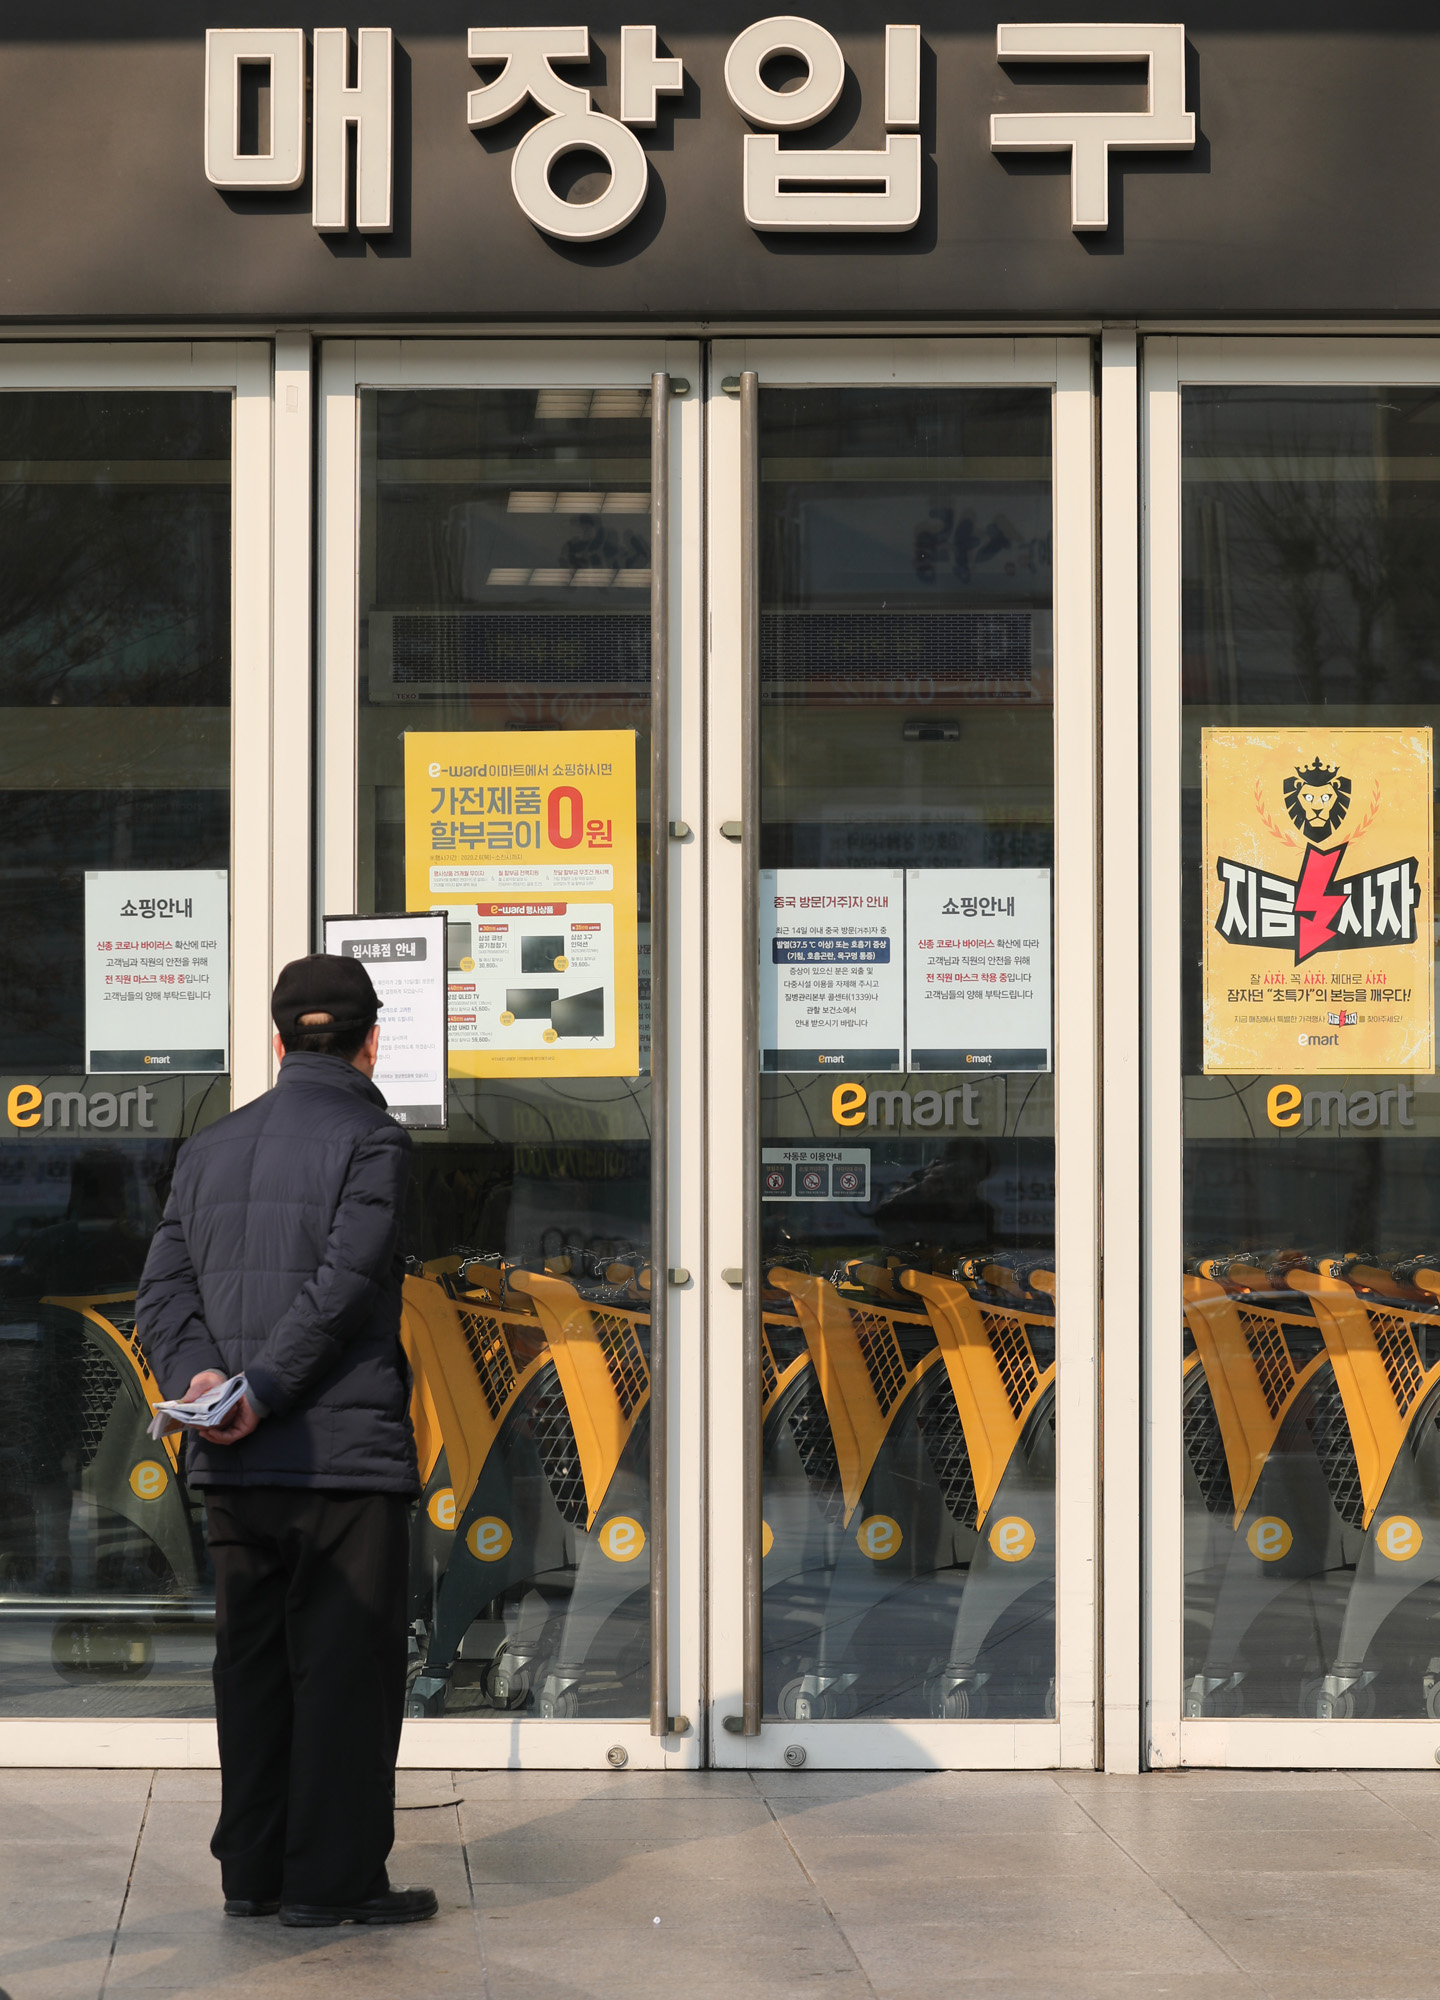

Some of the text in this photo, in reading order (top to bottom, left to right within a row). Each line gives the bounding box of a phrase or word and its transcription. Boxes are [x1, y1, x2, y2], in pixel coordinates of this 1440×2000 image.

[489, 764, 548, 776] 이마트에서
[553, 763, 612, 776] 쇼핑하시면
[431, 787, 541, 815] 가전제품
[430, 821, 540, 850] 할부금이
[773, 896, 888, 909] 중국 방문[거주]자 안내
[1222, 862, 1415, 938] 지금 사자
[120, 898, 192, 919] 쇼핑안내
[942, 897, 1014, 917] 쇼핑안내
[825, 927, 839, 935] 중국
[880, 926, 887, 934] 중
[97, 940, 217, 951] 신종 코로나 바이러스 확산에 따라
[818, 941, 834, 950] 이상)
[835, 941, 849, 950] 또는
[851, 941, 871, 950] 호흡기
[873, 941, 887, 950] 증상
[918, 939, 1039, 949] 신종 코로나 바이러스 확산에 따라
[352, 942, 416, 959] 임시휴점 안내
[787, 952, 875, 961] (기침, 호흡곤란, 목구멍 통증)
[927, 956, 1030, 966] 고객님과 직원의 안전을 위해
[106, 957, 208, 967] 고객님과 직원의 안전을 위해
[789, 967, 873, 975] 증상이 있으신 분은 외출 및
[105, 974, 209, 984] 전 직원 마스크 착용 중입니다
[926, 973, 1032, 983] 전 직원 마스크 착용 중입니다
[1250, 972, 1261, 986] 잘
[1290, 972, 1301, 986] 꼭
[1331, 972, 1362, 986] 제대로
[1365, 972, 1387, 986] 사자
[784, 980, 879, 988] 다중시설 이용을 자제해 주시고
[103, 991, 211, 1001] 고객님들의 양해 부탁드립니다
[925, 990, 1033, 1000] 고객님들의 양해 부탁드립니다
[1227, 988, 1264, 1003] 잠자던
[1330, 988, 1367, 1003] 본능을
[1370, 988, 1411, 1003] 깨우다!
[807, 1006, 820, 1014] 관할
[840, 1019, 868, 1027] 바랍니다
[1298, 1033, 1339, 1046] emart
[145, 1056, 170, 1064] emart
[818, 1054, 845, 1064] emart
[966, 1054, 992, 1064] emart
[7, 1084, 154, 1128] emart
[831, 1082, 979, 1127] emart
[1267, 1084, 1414, 1128] emart
[783, 1152, 842, 1161] 자동문 이용안내
